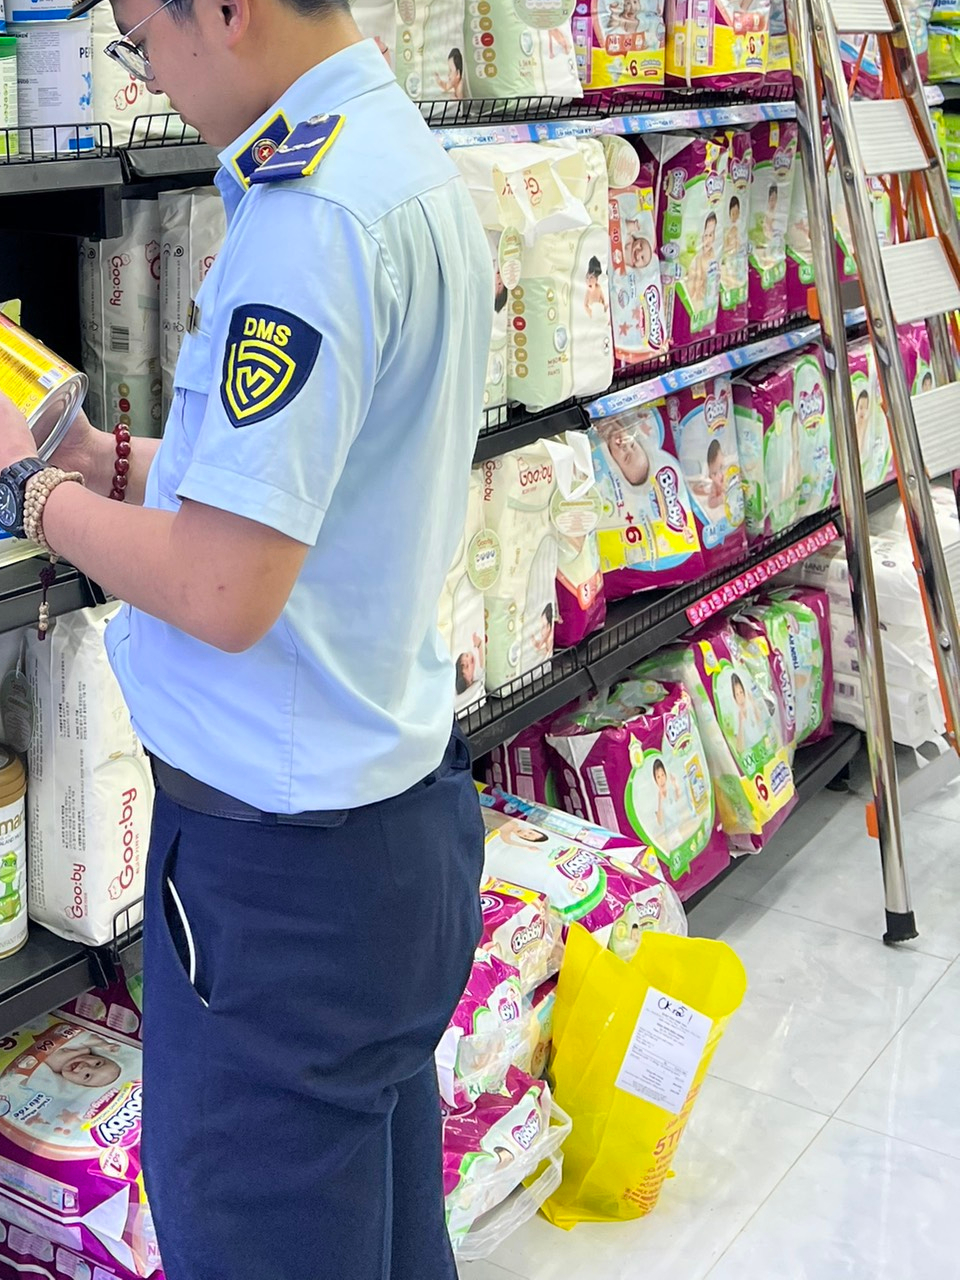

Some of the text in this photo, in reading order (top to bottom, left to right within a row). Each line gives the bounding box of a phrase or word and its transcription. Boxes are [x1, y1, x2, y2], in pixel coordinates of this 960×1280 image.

[109, 256, 122, 307] Goo:by
[242, 315, 292, 348] DMS
[646, 289, 663, 347] Bobby
[519, 464, 552, 487] Goo:by
[662, 470, 686, 527] Bobby
[119, 788, 137, 889] Goo:by
[71, 863, 86, 918] Goo:by
[513, 920, 541, 948] Bobby
